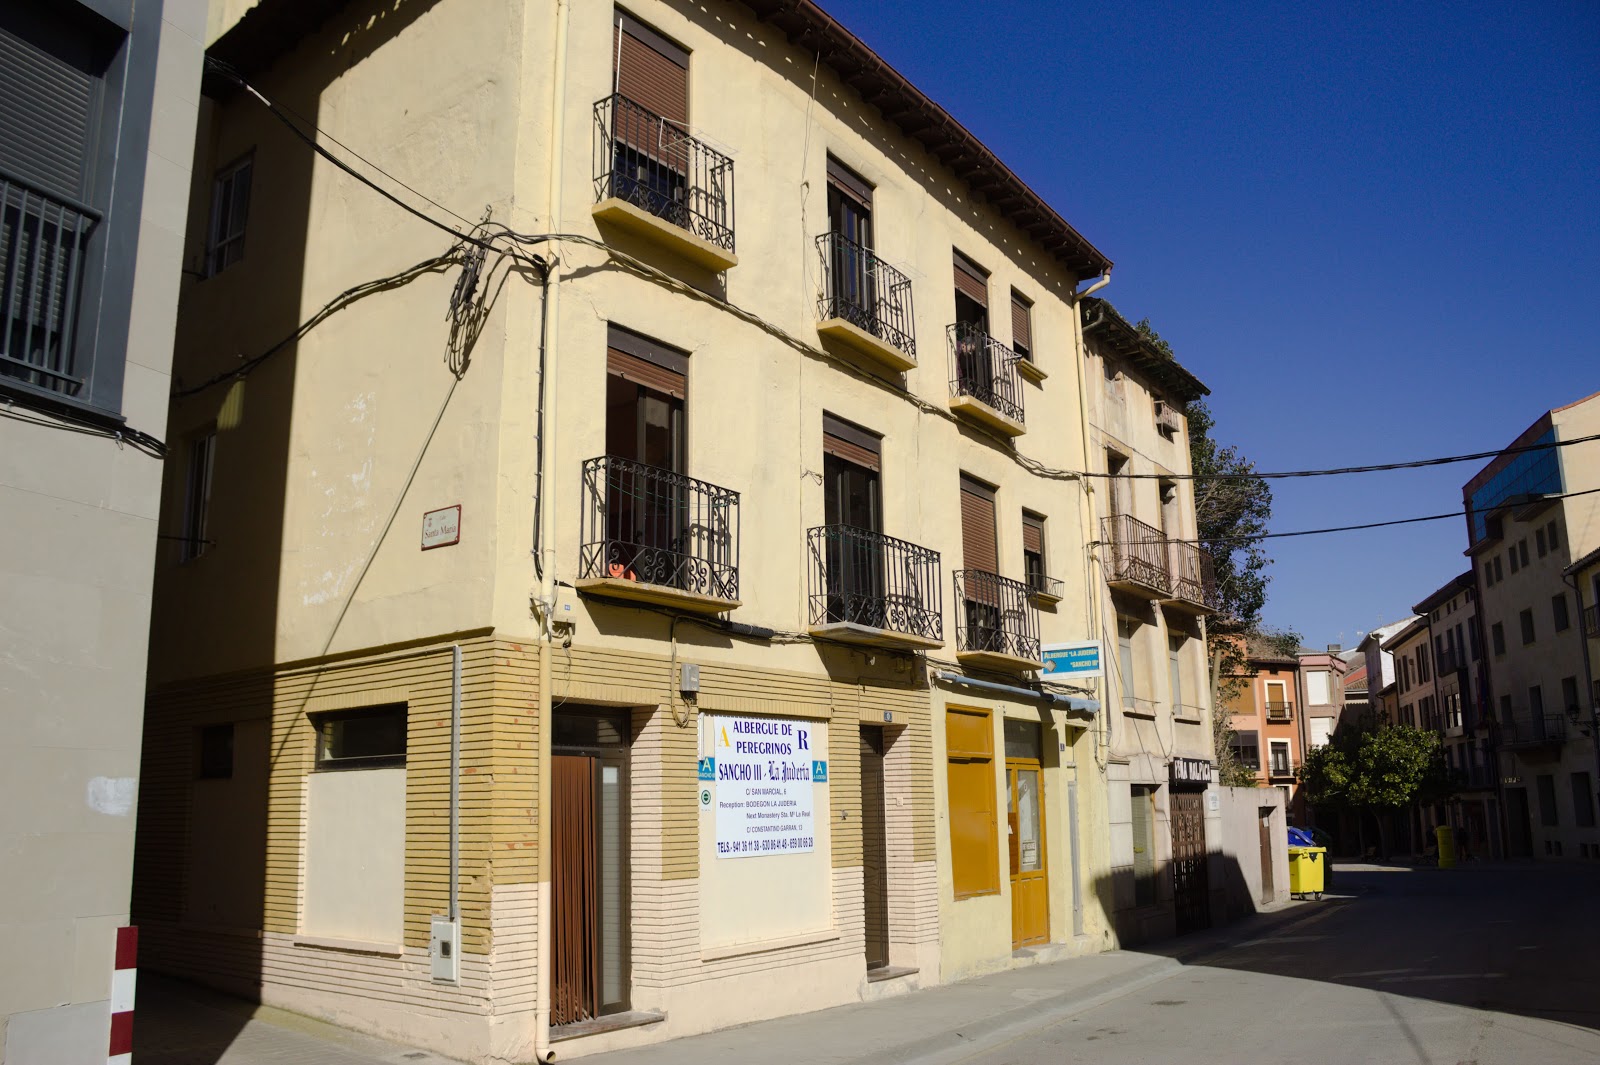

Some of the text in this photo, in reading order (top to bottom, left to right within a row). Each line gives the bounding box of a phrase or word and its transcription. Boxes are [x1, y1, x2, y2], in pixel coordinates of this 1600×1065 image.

[425, 524, 456, 539] Santa María
[733, 721, 792, 736] ALBERGUE DE
[718, 726, 730, 747] A
[797, 730, 809, 750] R
[736, 741, 792, 755] PEREGRINOS
[702, 758, 712, 771] A
[719, 763, 751, 781] SANCHO
[768, 760, 780, 781] La
[815, 761, 824, 774] A
[1174, 758, 1188, 779] PEÑA
[742, 841, 747, 851] 36
[748, 841, 753, 851] 11
[754, 840, 759, 851] 38
